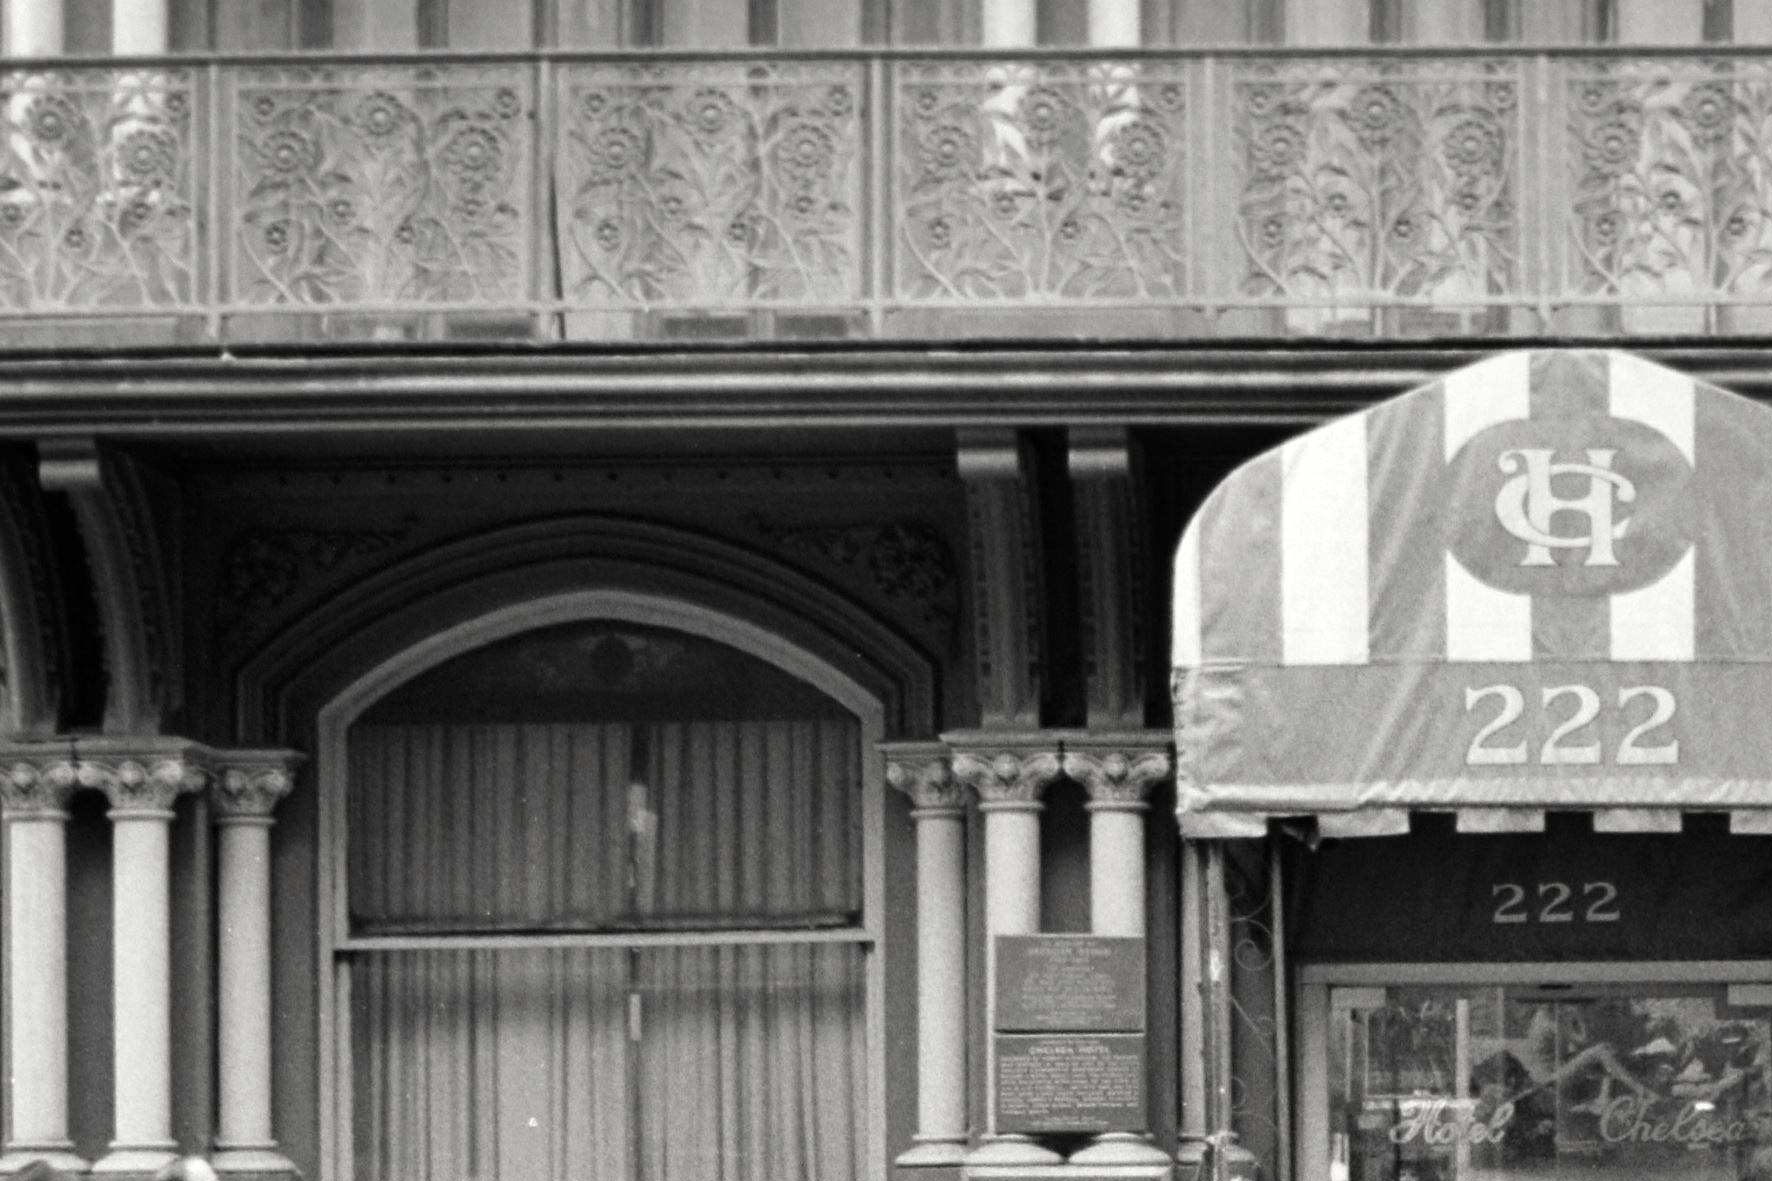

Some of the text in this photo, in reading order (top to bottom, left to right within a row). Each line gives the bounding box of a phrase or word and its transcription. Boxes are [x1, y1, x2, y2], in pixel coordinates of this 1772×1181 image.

[1464, 684, 1680, 767] 222
[1492, 881, 1621, 924] 222
[1389, 1096, 1745, 1143] Hotel Chelsea
